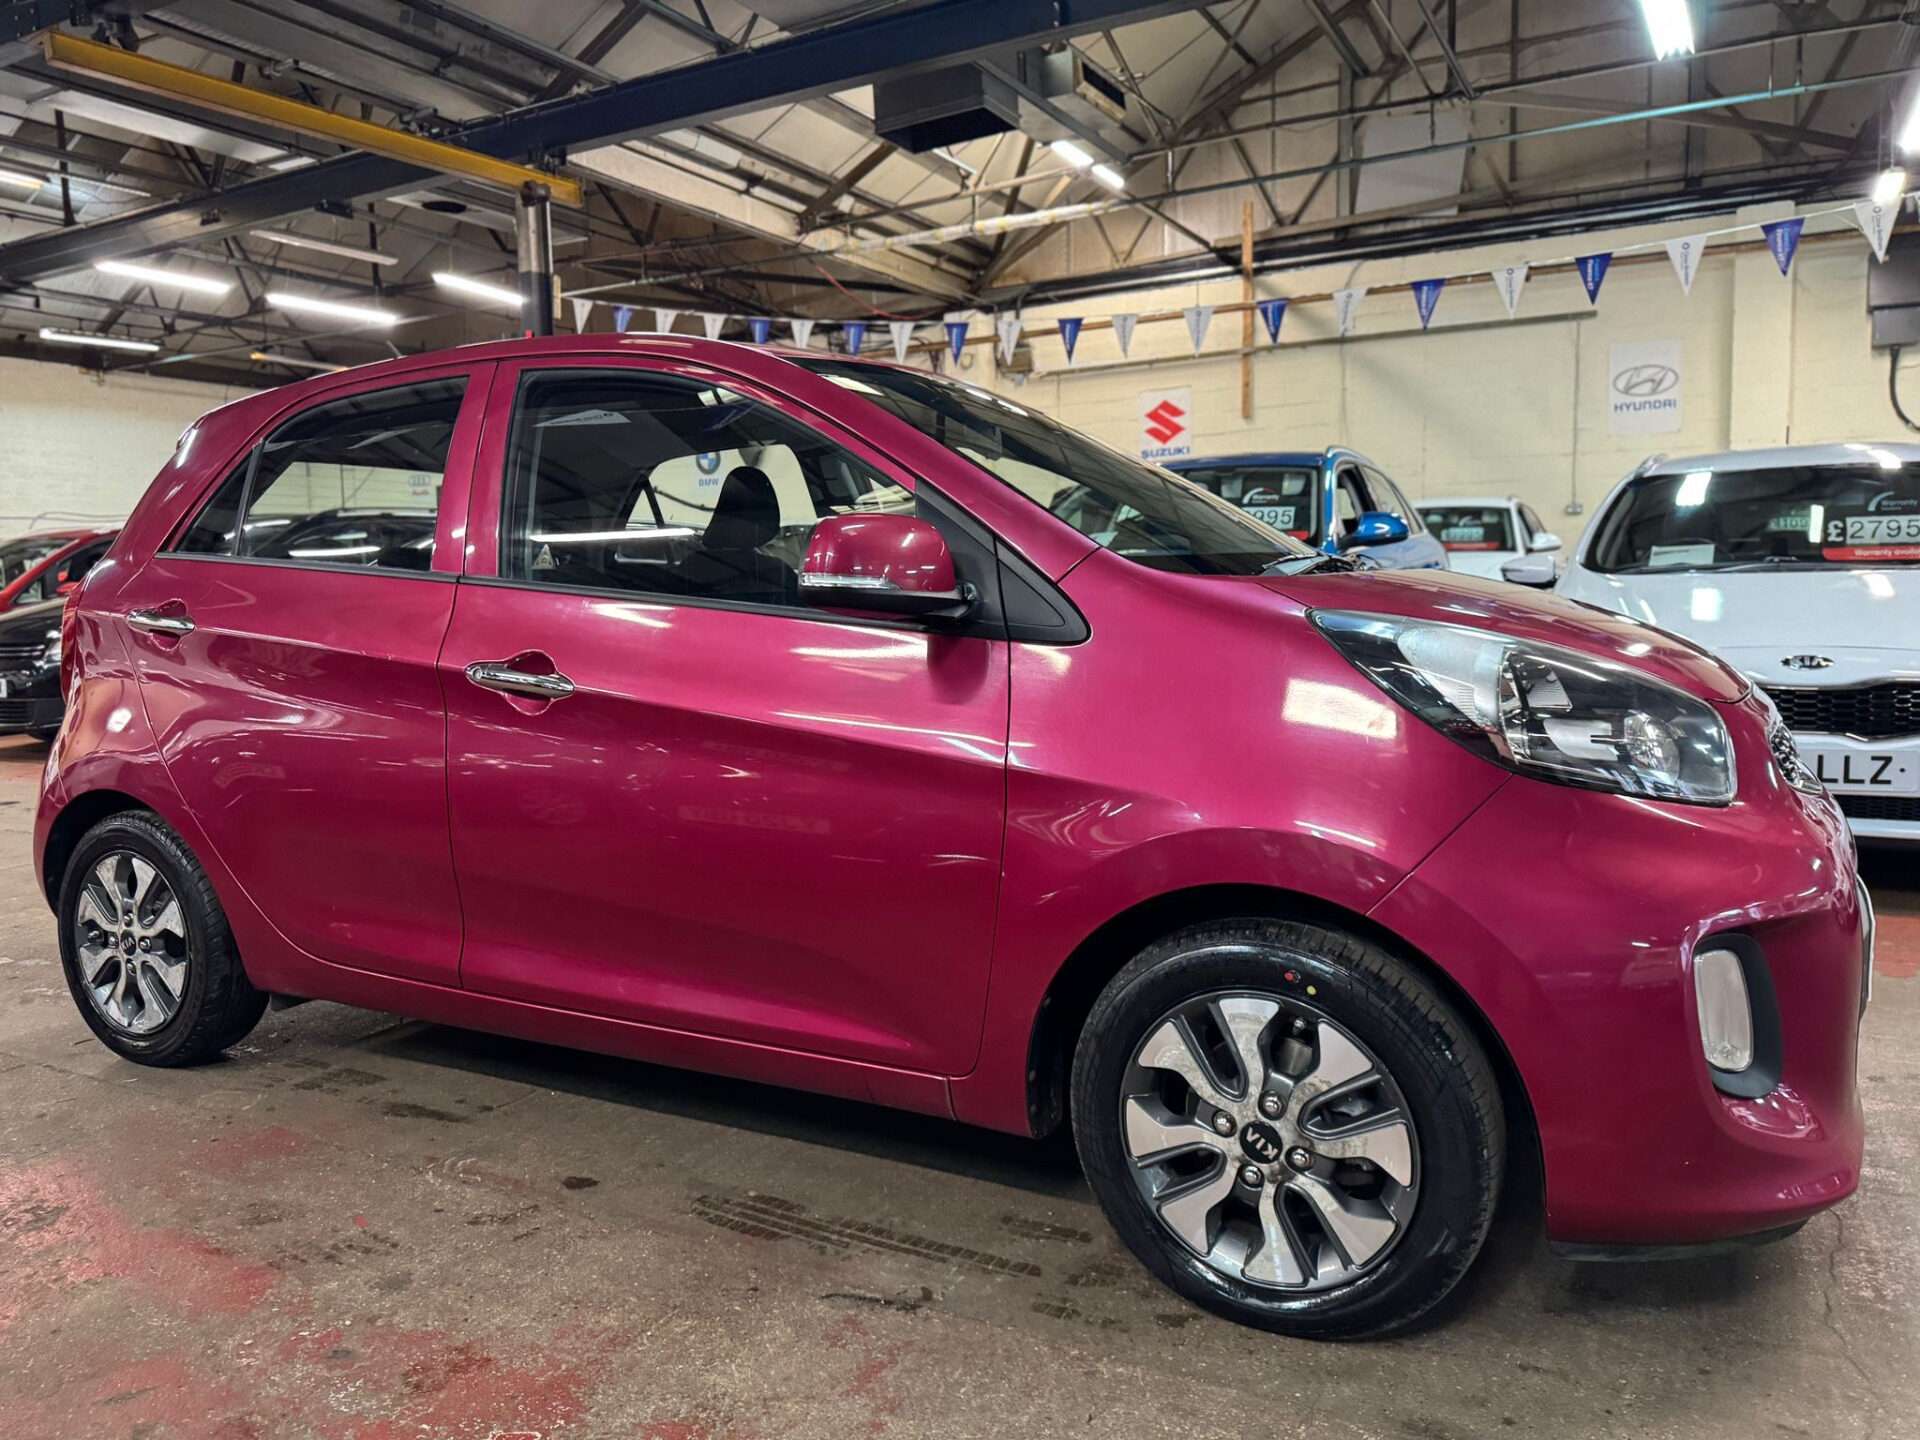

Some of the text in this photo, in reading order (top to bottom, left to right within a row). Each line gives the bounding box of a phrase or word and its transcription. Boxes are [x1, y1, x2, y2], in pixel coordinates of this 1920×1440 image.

[1614, 399, 1677, 412] HYUNDAI
[1141, 446, 1190, 459] SUZUKI
[1246, 1126, 1279, 1160] KIA
